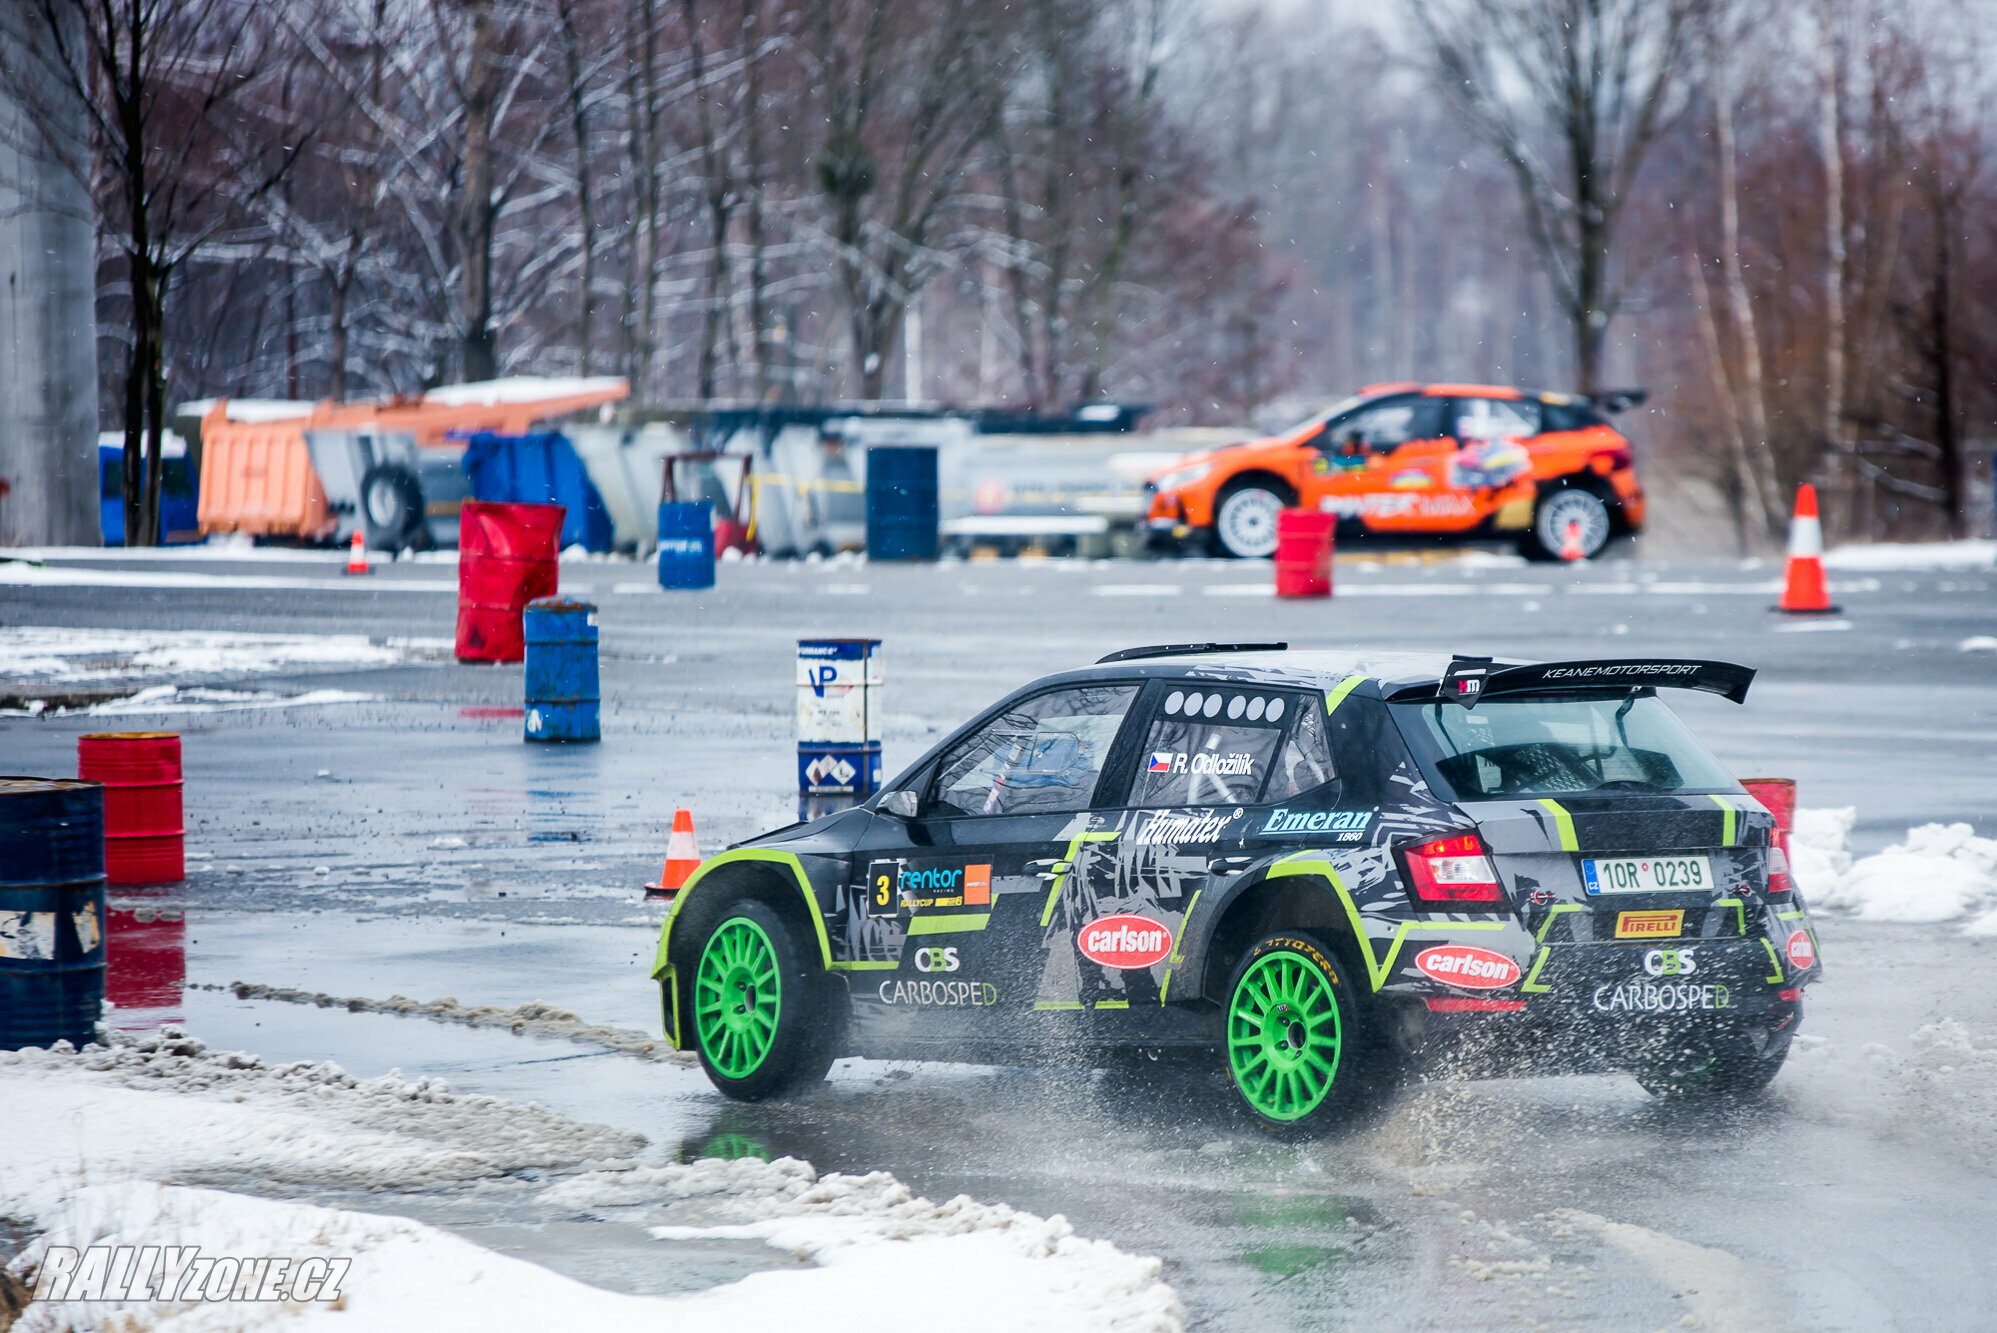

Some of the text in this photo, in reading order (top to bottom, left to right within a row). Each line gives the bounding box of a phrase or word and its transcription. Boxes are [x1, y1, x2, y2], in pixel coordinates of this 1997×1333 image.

[808, 665, 838, 698] VP
[1542, 665, 1702, 679] KEANEMOTORSPORT
[1172, 752, 1255, 775] R. Odložilík
[1261, 808, 1373, 832] Emeran
[1336, 832, 1364, 842] 1860
[900, 867, 963, 890] rentor
[1588, 860, 1703, 891] CZ 10R 0239
[876, 875, 890, 906] 3
[1621, 914, 1679, 933] PIRELLI
[1088, 925, 1162, 952] carlson
[915, 946, 960, 973] CBS
[1426, 954, 1510, 980] carlson
[1643, 949, 1697, 976] CBS
[879, 980, 998, 1007] CARBOSPED
[1593, 984, 1730, 1011] CARBOSPED
